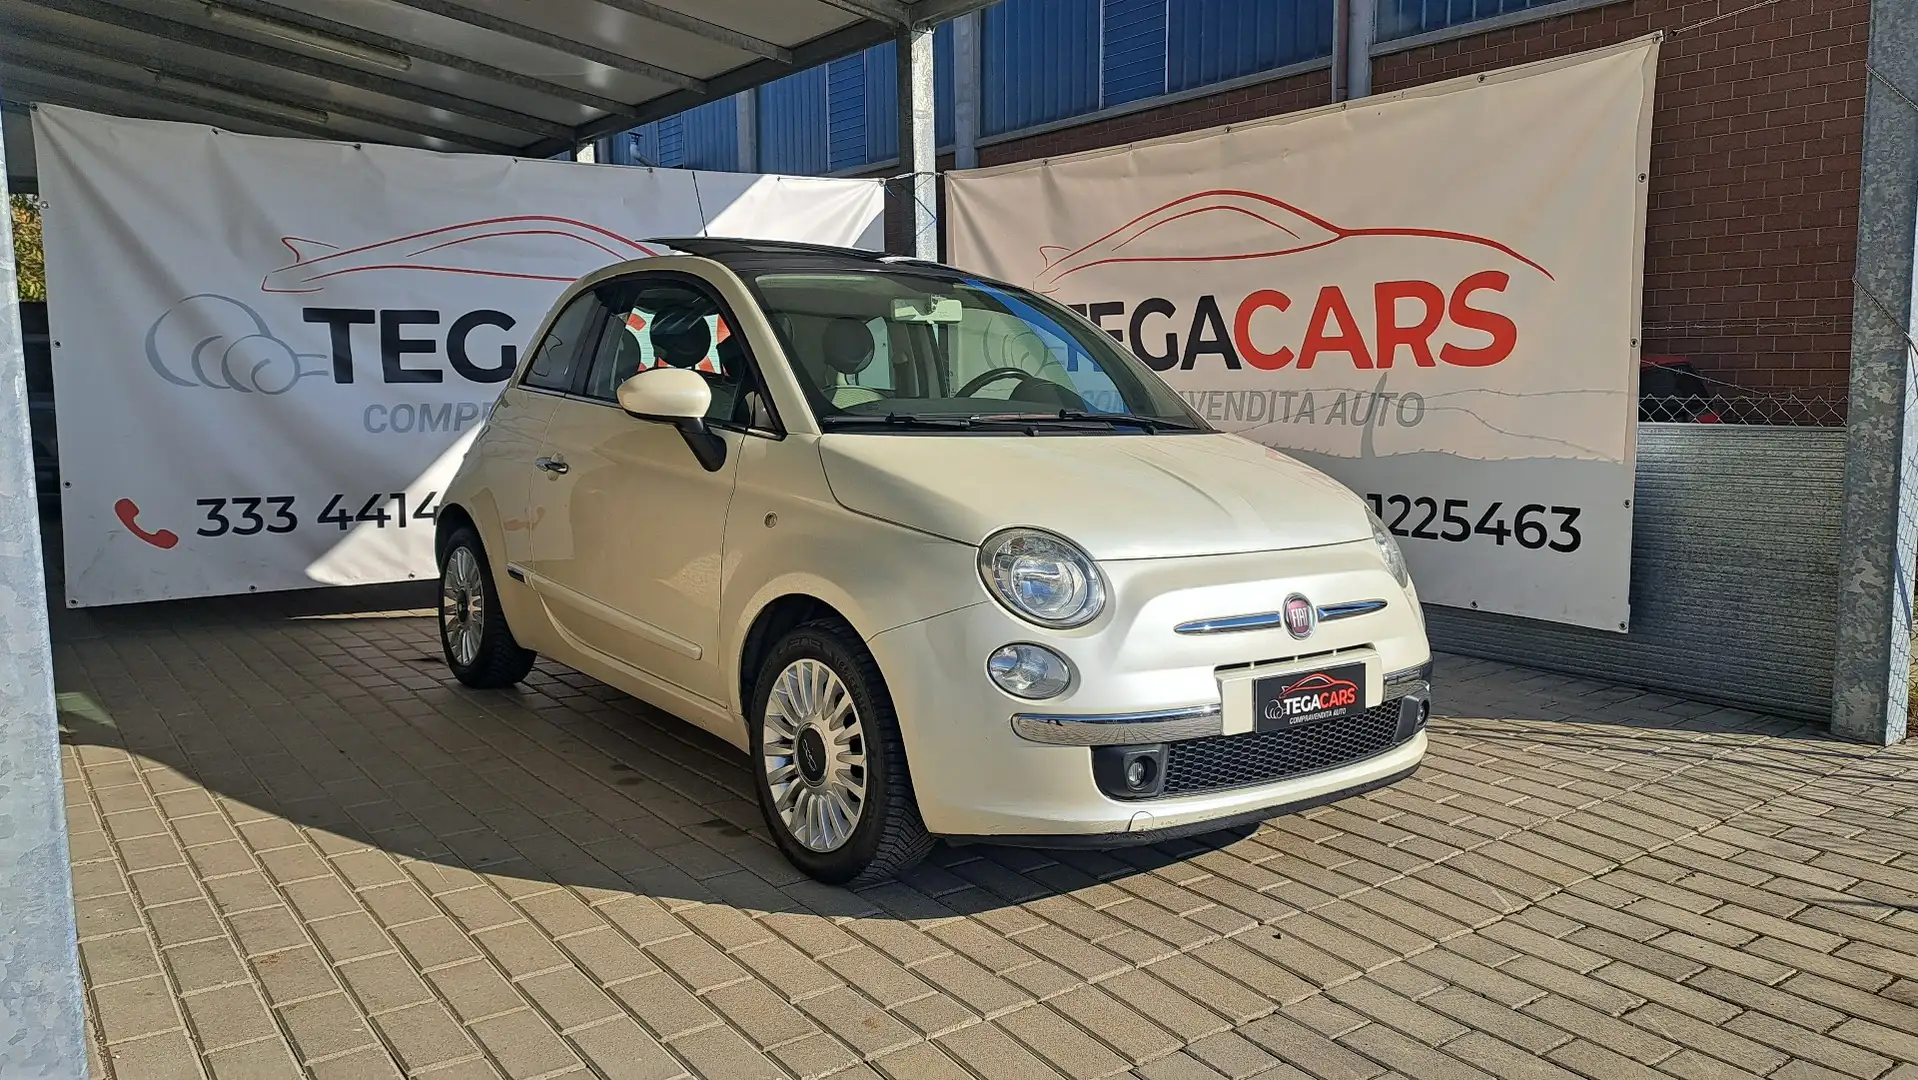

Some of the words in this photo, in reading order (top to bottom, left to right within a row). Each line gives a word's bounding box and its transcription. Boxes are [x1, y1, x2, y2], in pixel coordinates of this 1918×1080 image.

[1324, 391, 1425, 428] AUTO
[196, 495, 298, 537] 333
[317, 491, 440, 530] 4414
[1366, 493, 1582, 553] 1225463
[1290, 607, 1309, 628] FIAT
[1283, 687, 1356, 715] TEGACARS
[1333, 707, 1347, 717] AUTO
